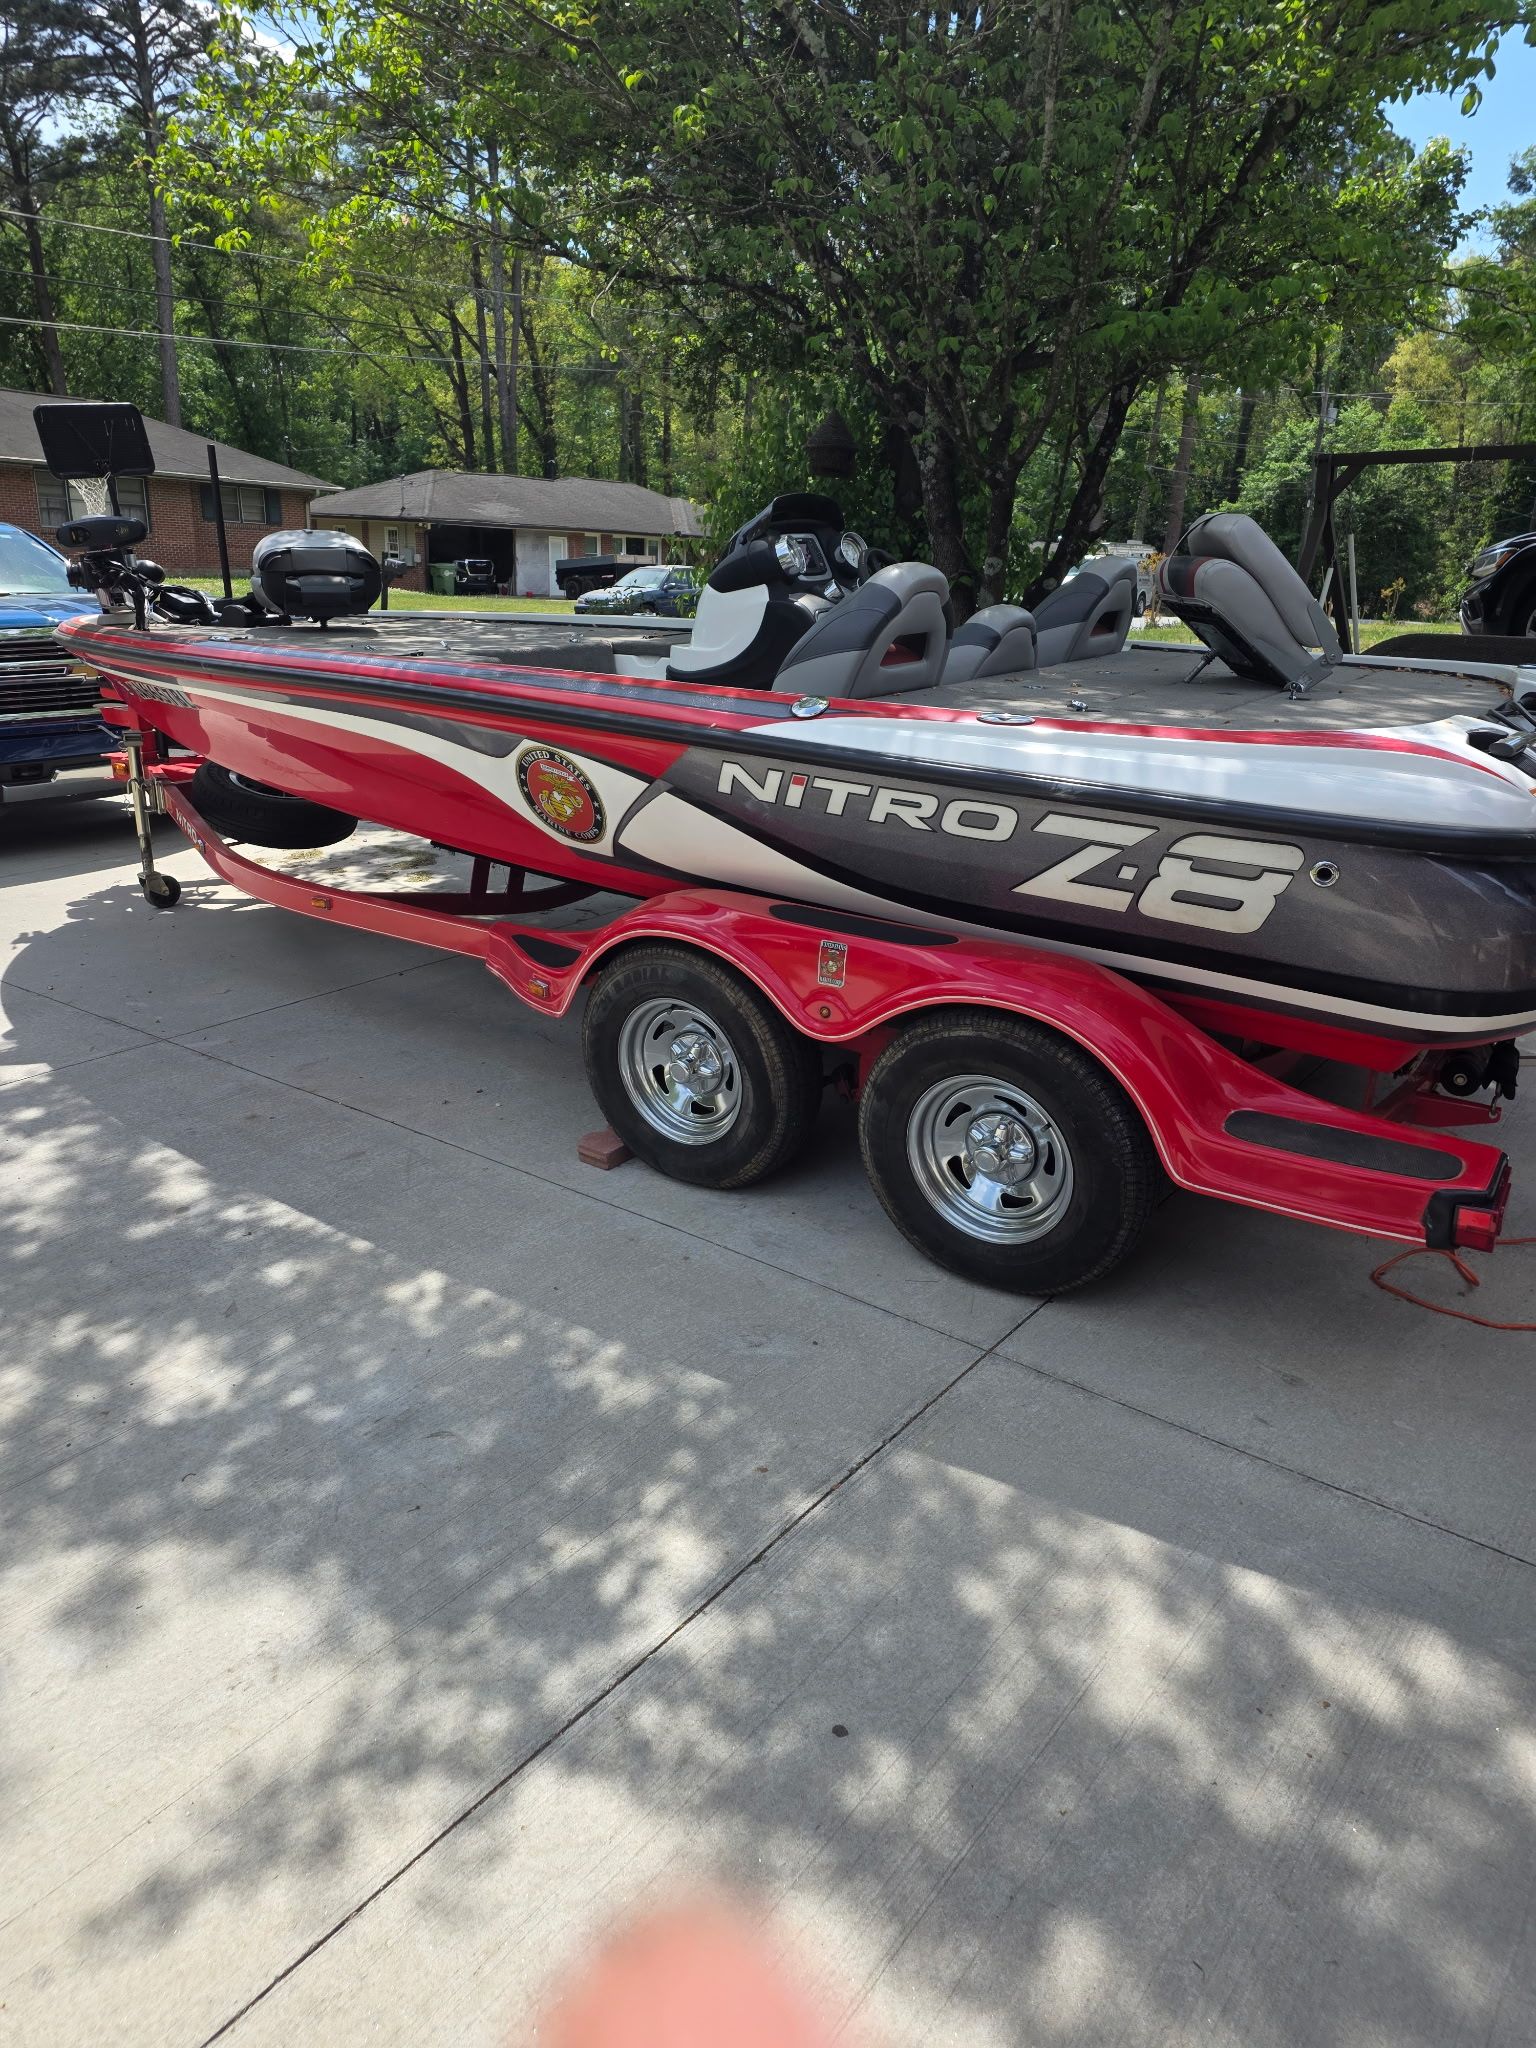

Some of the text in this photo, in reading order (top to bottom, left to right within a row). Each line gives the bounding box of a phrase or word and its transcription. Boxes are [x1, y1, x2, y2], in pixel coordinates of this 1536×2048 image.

[521, 750, 550, 767] UNITED
[554, 754, 591, 791] STATES
[533, 804, 600, 840] MARINE CORPS
